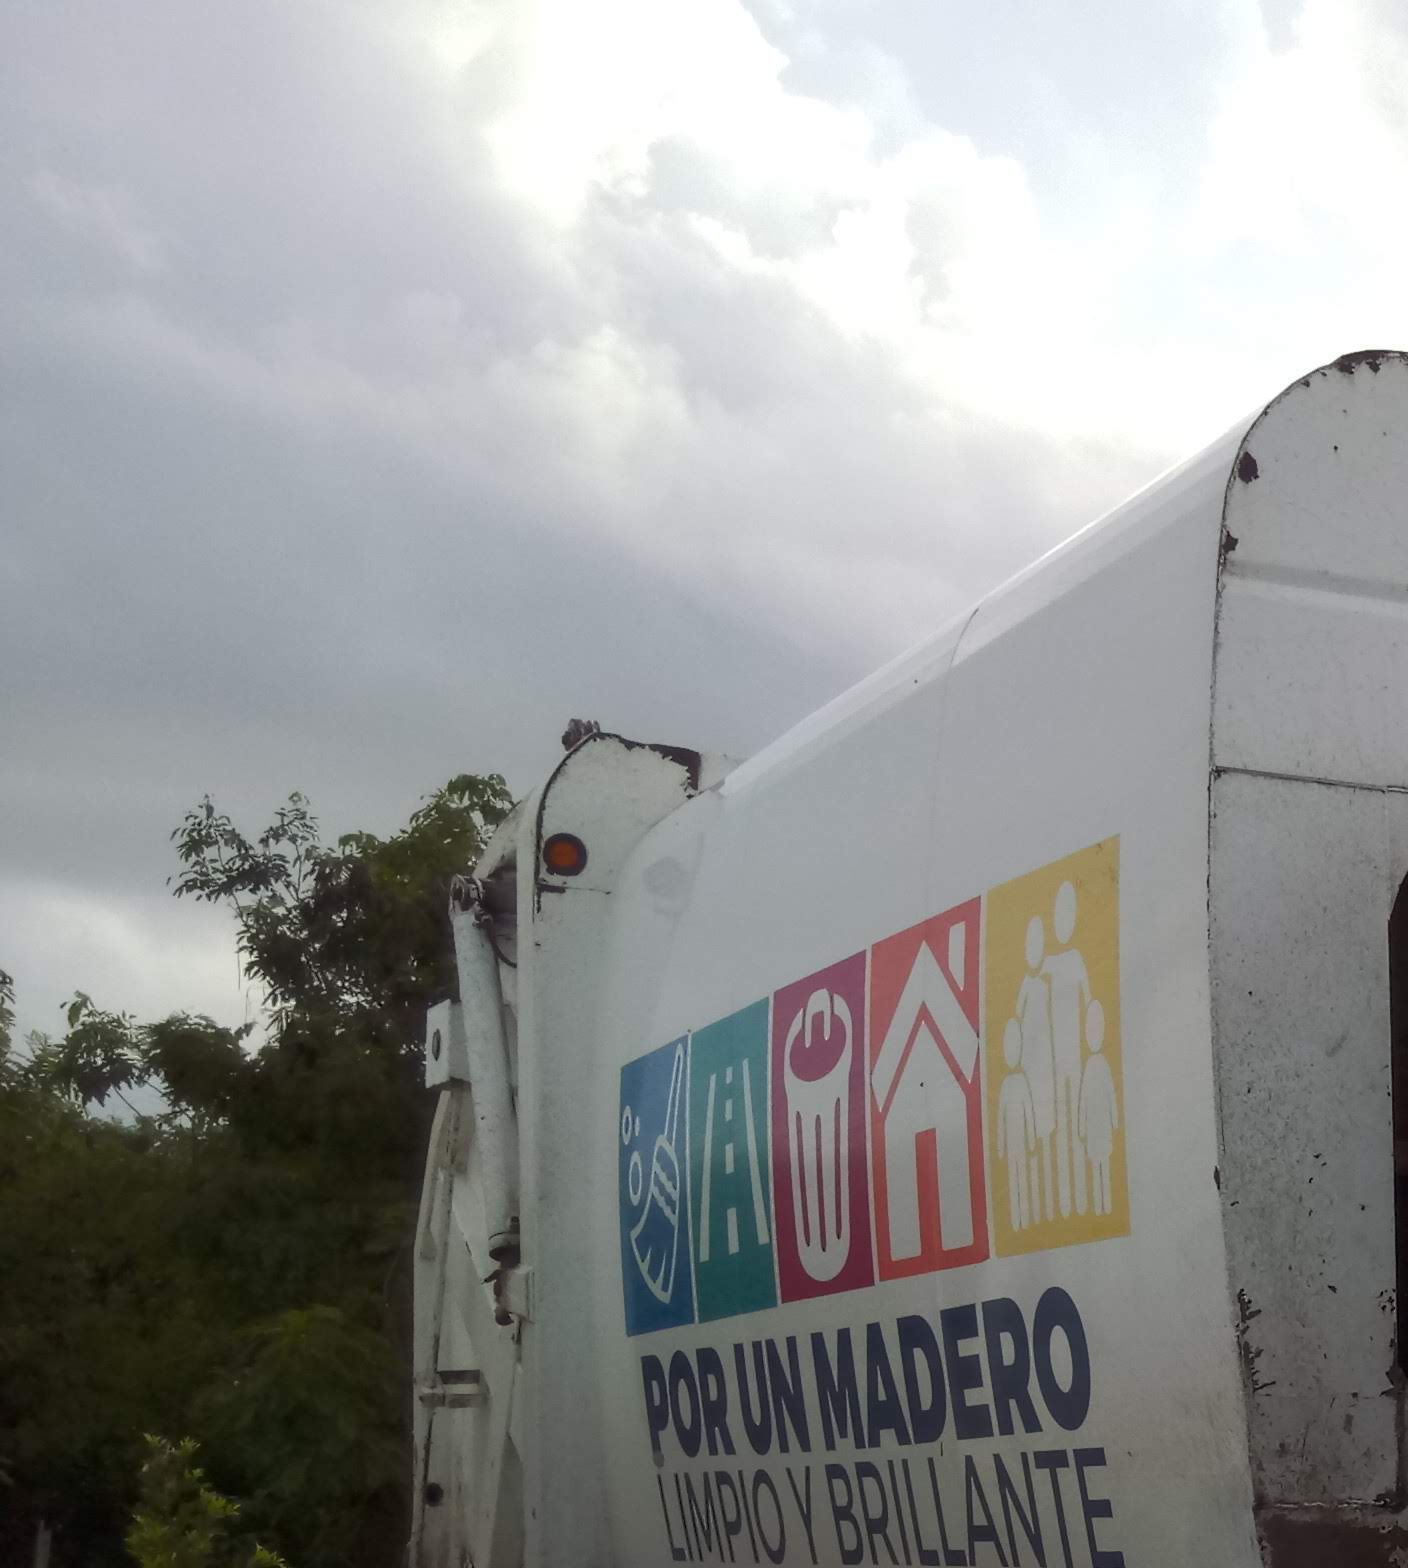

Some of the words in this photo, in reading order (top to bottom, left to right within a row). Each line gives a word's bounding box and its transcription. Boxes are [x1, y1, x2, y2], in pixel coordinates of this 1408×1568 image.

[641, 1347, 736, 1458] POR
[734, 1335, 811, 1456] UN
[811, 1286, 1091, 1451] MADERO
[657, 1469, 786, 1564] LIMPIO
[786, 1466, 818, 1565] Y
[825, 1447, 1126, 1568] BRILLANTE
